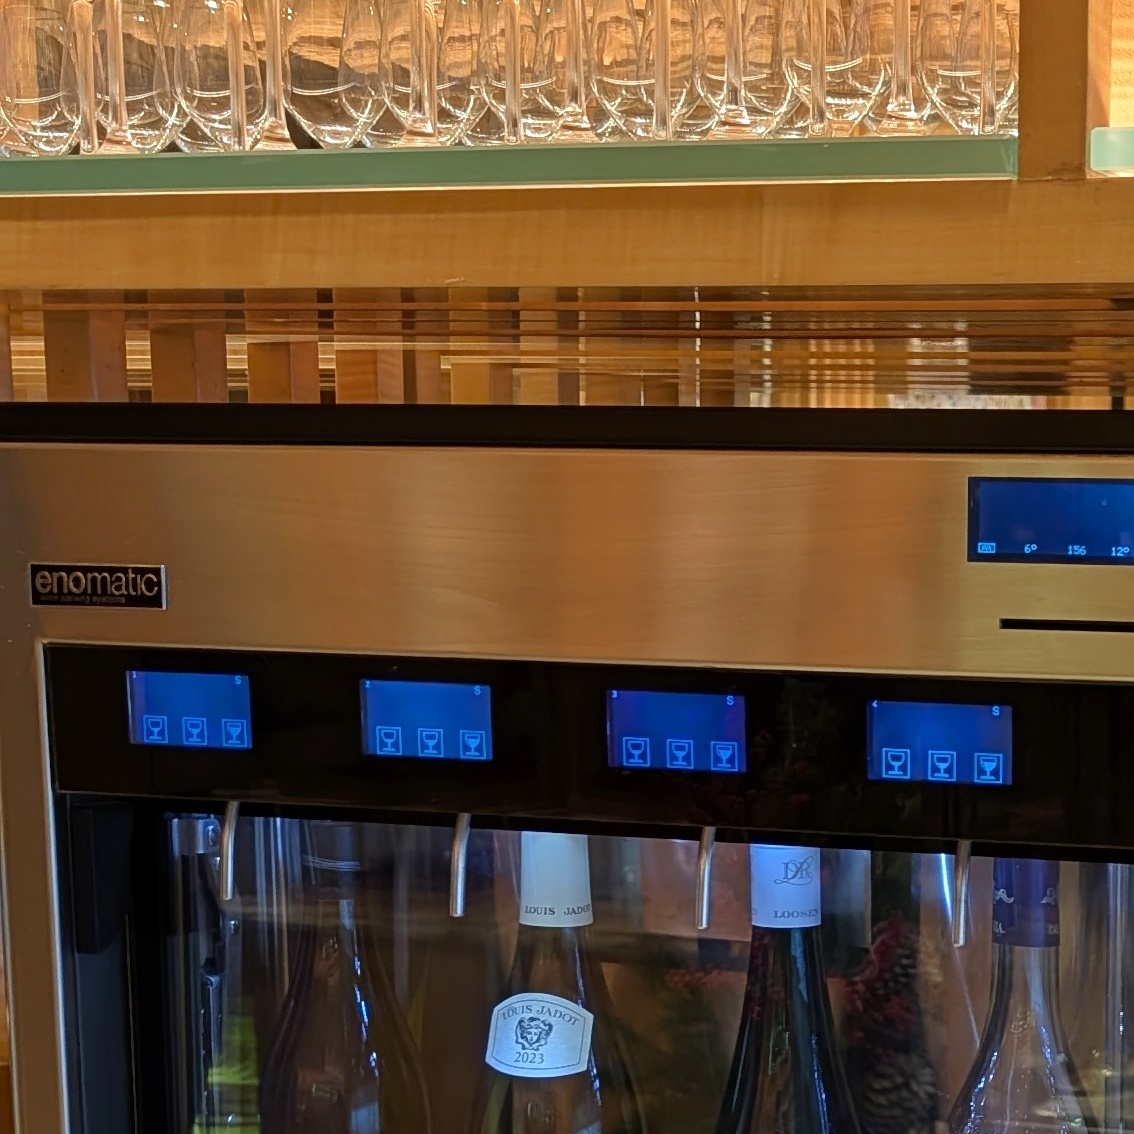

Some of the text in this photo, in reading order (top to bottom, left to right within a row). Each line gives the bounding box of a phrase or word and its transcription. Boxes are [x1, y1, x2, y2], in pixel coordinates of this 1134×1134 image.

[1067, 545, 1087, 556] 156
[34, 568, 159, 597] enomatic
[234, 675, 242, 685] S
[473, 685, 482, 696] S
[726, 695, 735, 706] S
[991, 705, 1000, 716] S
[524, 905, 556, 916] LOUIS
[502, 1004, 580, 1027] LOUIS JADOT
[513, 1051, 545, 1065] 2023
